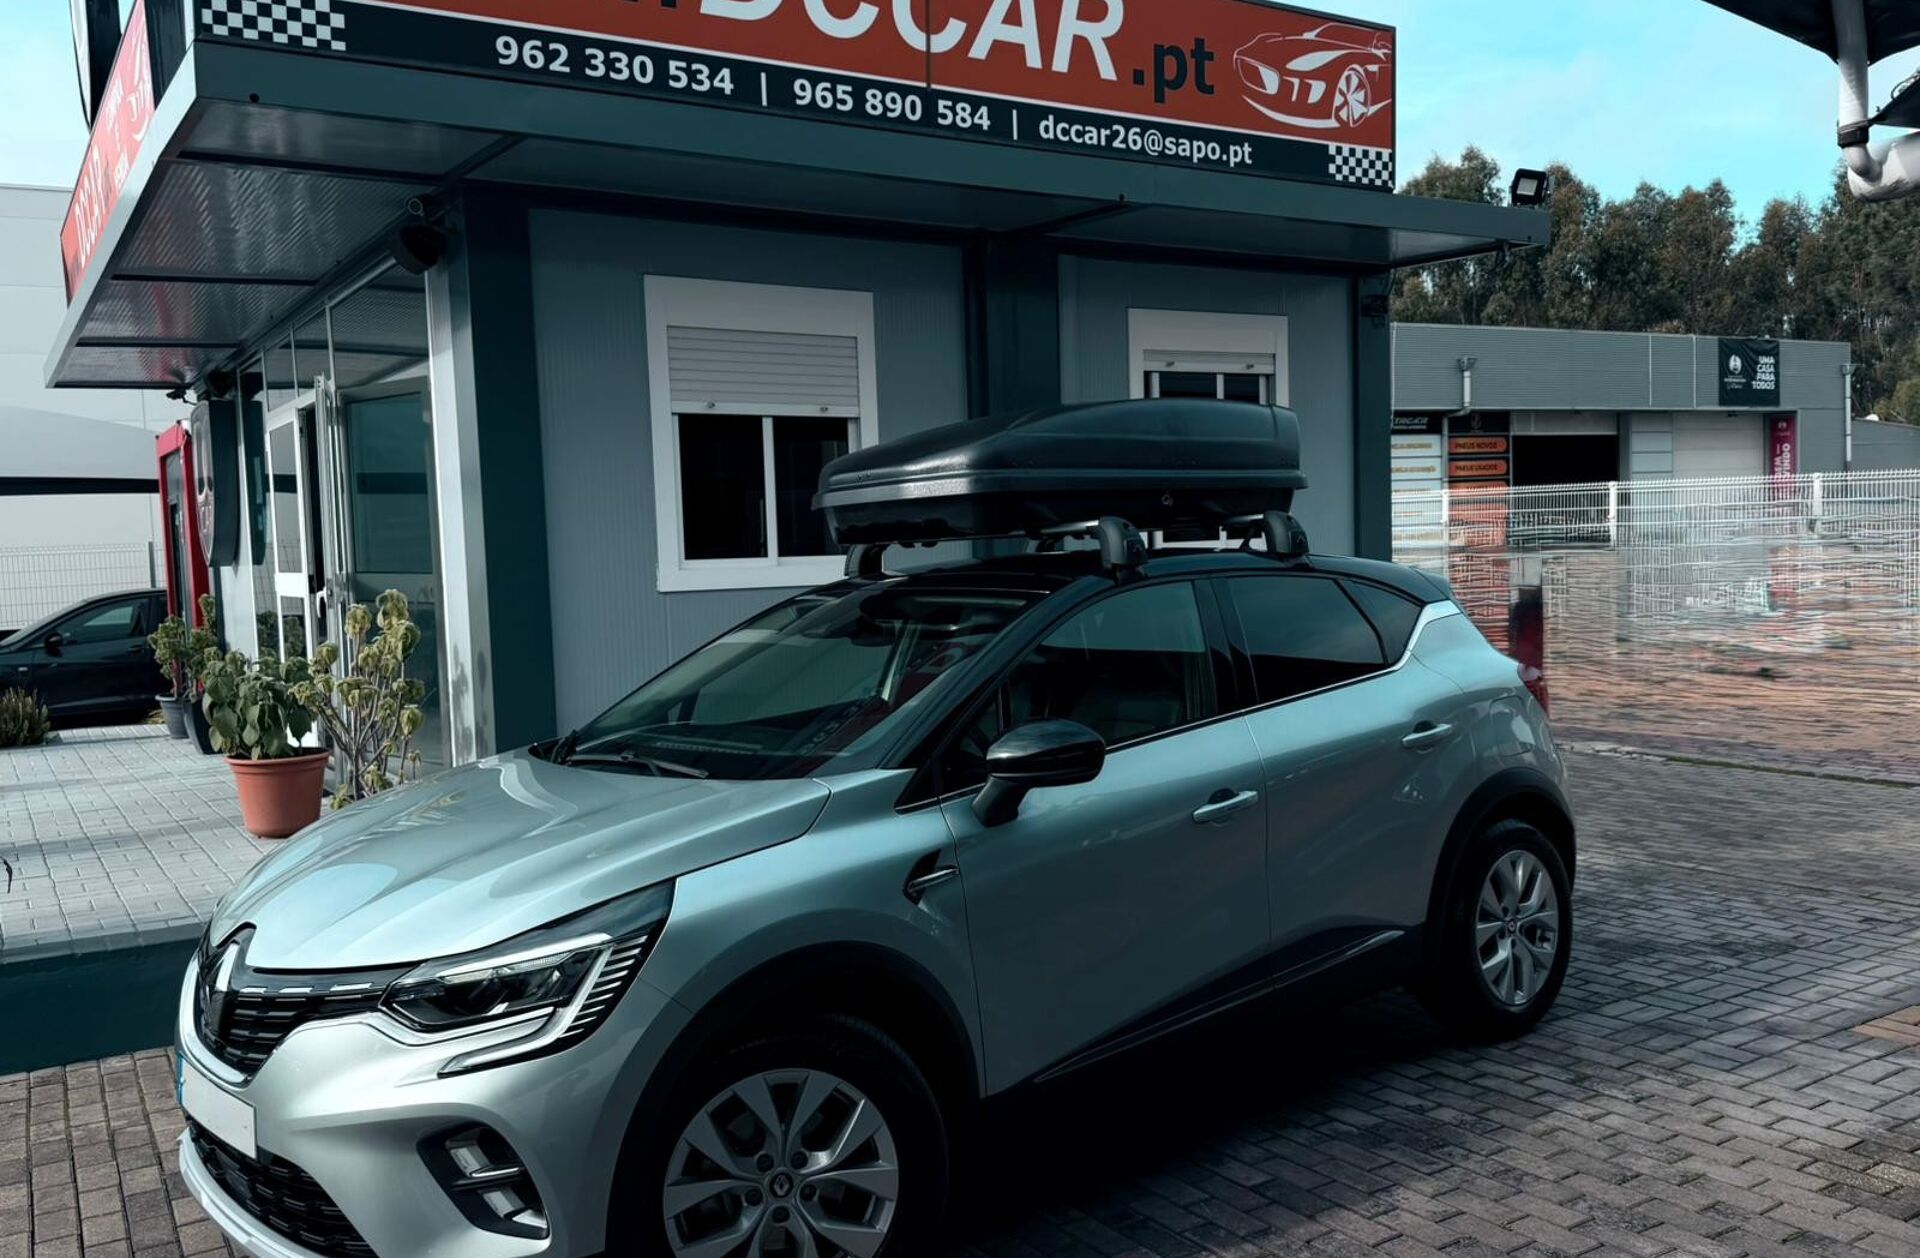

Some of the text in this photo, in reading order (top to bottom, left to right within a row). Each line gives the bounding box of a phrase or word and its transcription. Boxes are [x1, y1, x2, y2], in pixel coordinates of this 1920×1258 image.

[495, 35, 571, 73] 962
[584, 48, 655, 84] 330
[668, 61, 734, 96] 534
[792, 78, 854, 112] 965
[865, 87, 922, 122] 890
[936, 100, 991, 130] 584
[1039, 115, 1253, 166] dccar26@sapo.pt
[1758, 355, 1775, 364] UMA
[1752, 381, 1775, 389] TODOS
